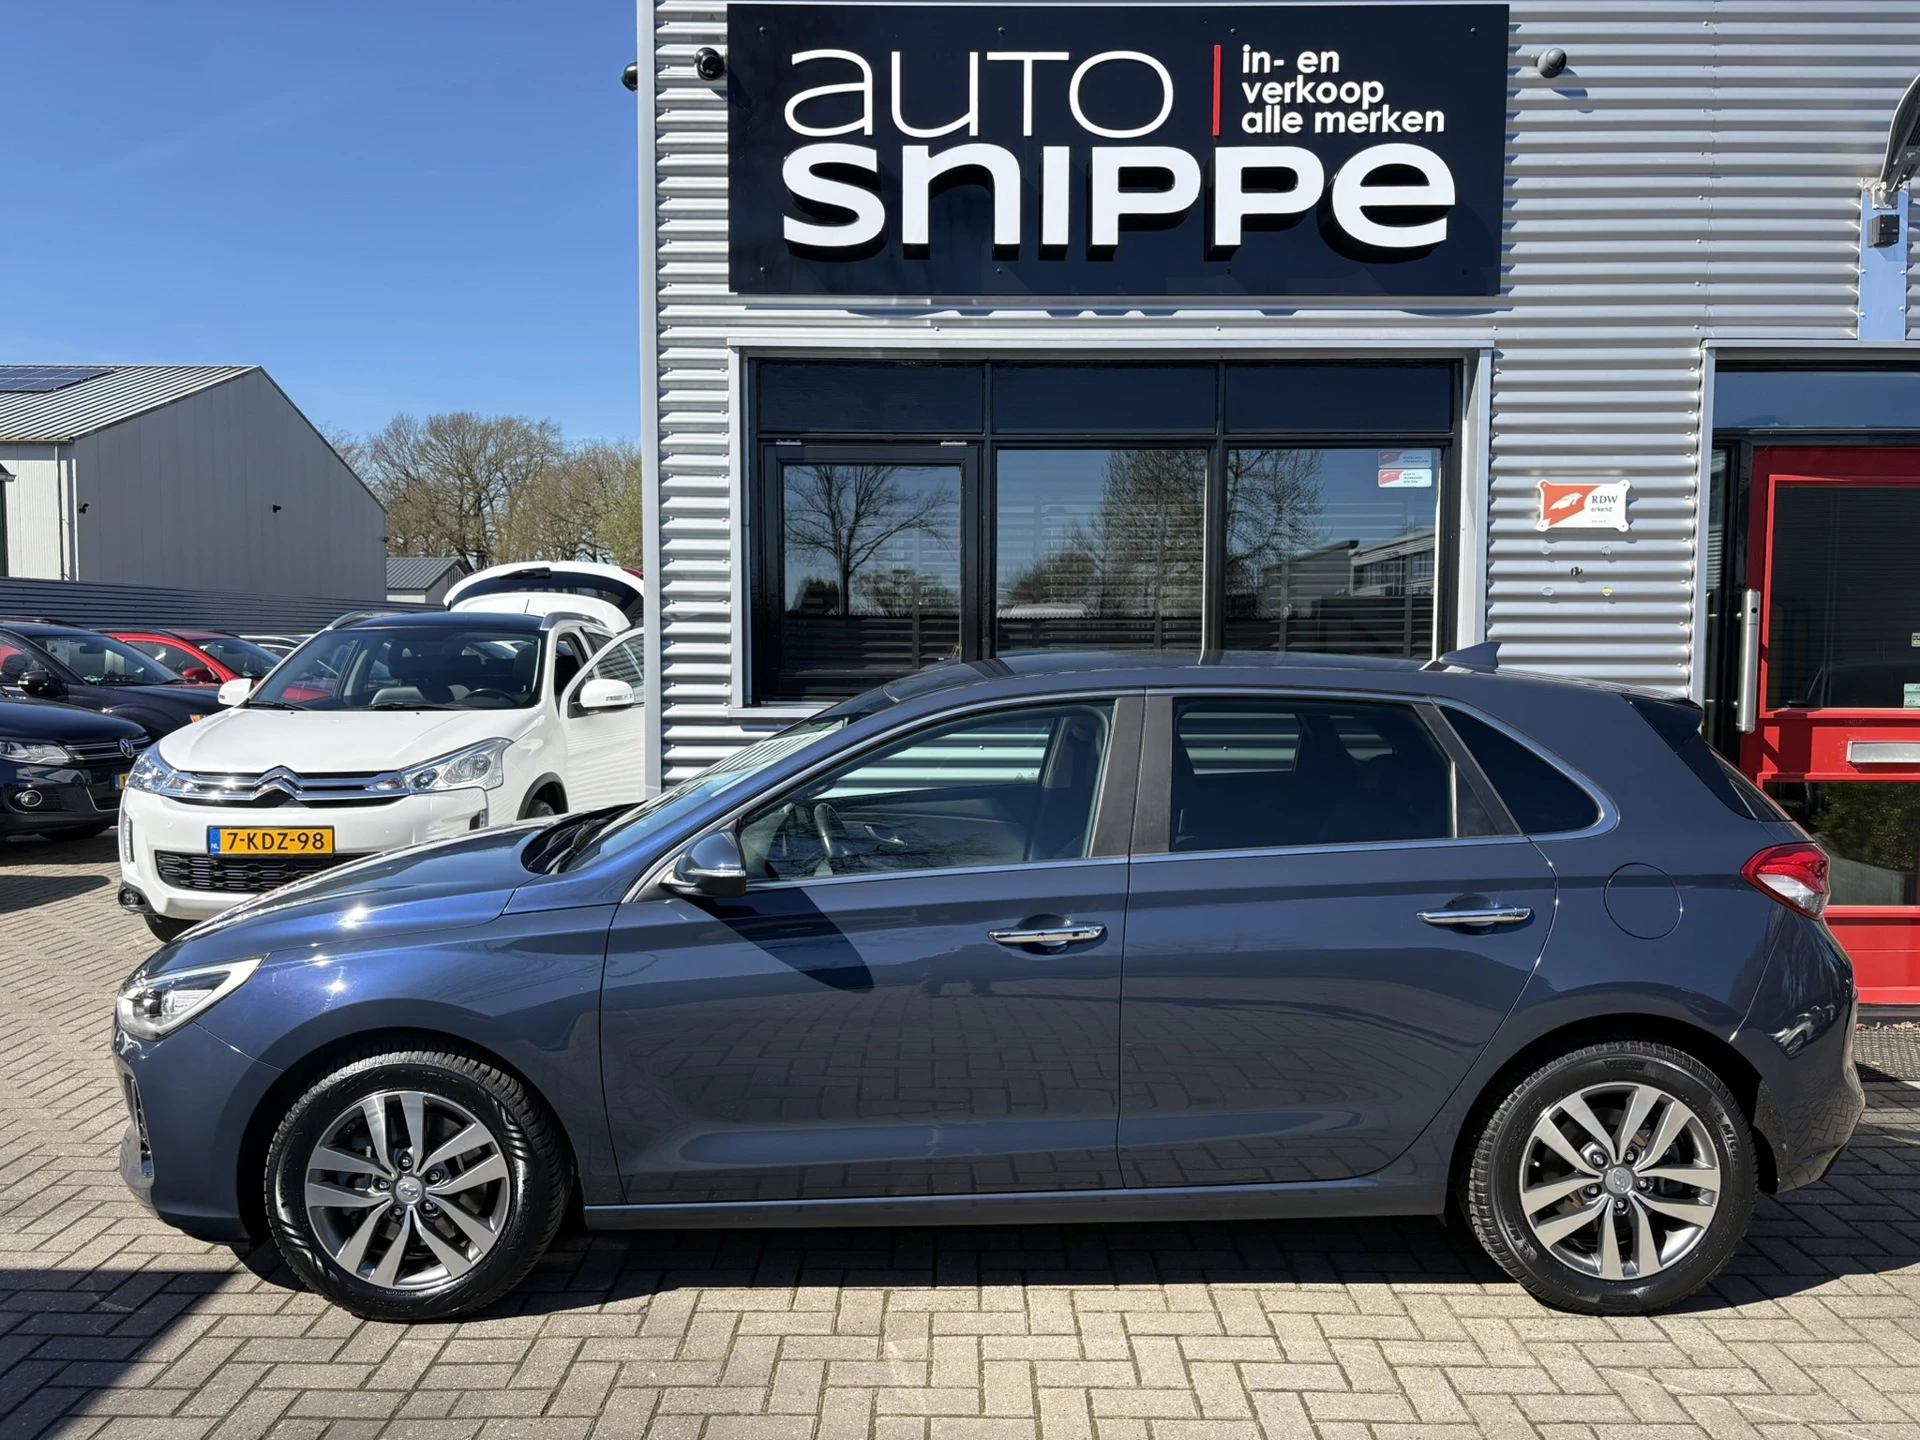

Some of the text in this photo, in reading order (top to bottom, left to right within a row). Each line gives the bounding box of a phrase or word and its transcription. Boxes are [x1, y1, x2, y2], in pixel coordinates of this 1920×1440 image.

[1242, 44, 1340, 74] in- en
[1241, 75, 1385, 110] verkoop
[1241, 104, 1445, 134] alle merken
[1591, 495, 1618, 504] RDW
[210, 832, 325, 850] NL 7-KDZ-98
